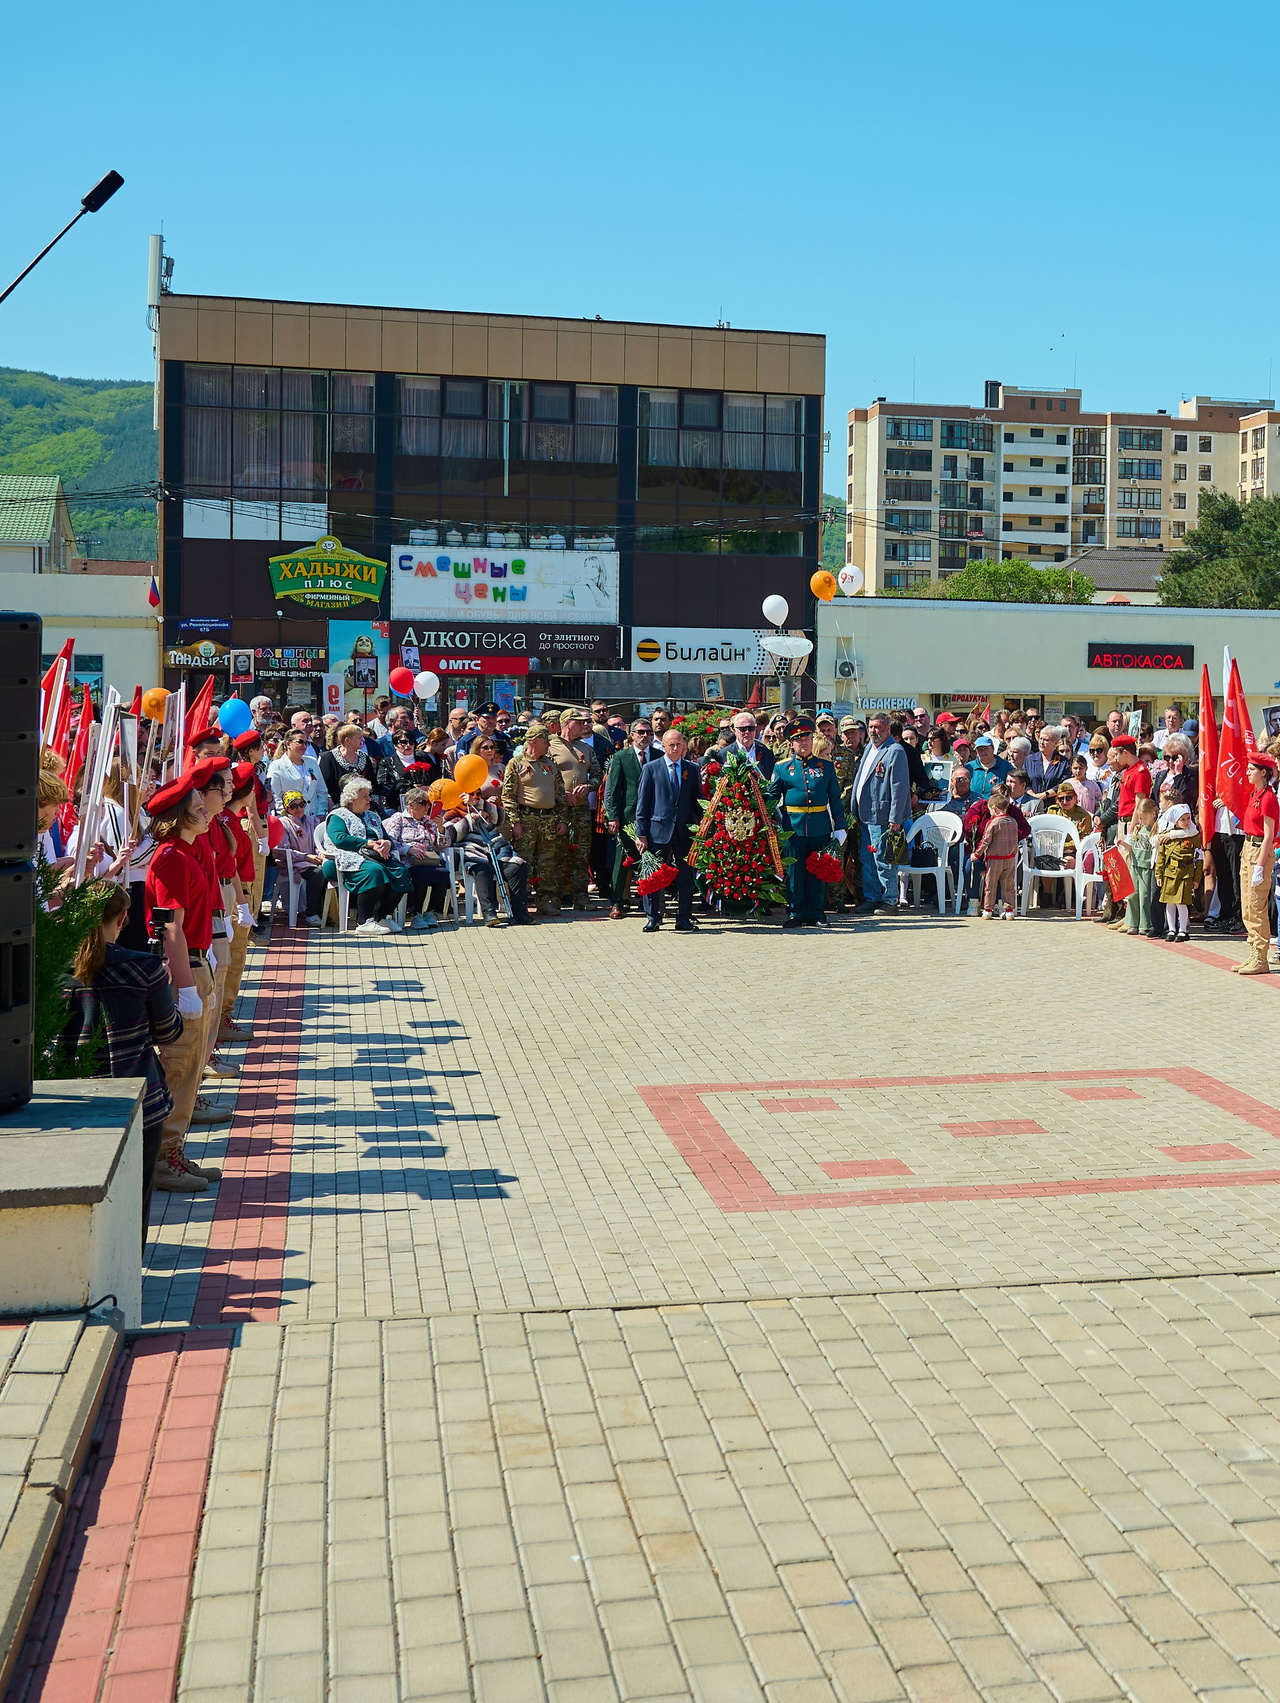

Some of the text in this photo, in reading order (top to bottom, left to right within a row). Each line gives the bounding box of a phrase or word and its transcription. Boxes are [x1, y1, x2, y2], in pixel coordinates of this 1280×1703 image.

[279, 561, 377, 585] ХАДЫЖИ
[304, 580, 353, 590] ПЛЮС
[306, 600, 349, 609] МАГАЗИН
[403, 608, 447, 619] ОДЕЖДА
[457, 610, 465, 619] И
[466, 610, 500, 620] ОБУВЬ
[508, 611, 528, 620] ДЛЯ
[530, 611, 557, 620] ВСЕЙ
[539, 632, 600, 642] От элитного
[538, 642, 595, 651] до простого
[665, 642, 745, 661] Билайн
[169, 650, 231, 667] ТАНДЫР-Т
[254, 648, 326, 659] СМЕШНЫЕ
[269, 658, 312, 669] ЦЕНЫ
[448, 659, 481, 670] МТС
[1092, 655, 1184, 669] АВТОКАССА
[287, 670, 308, 678] ЦЕНЫ
[856, 697, 918, 710] ТАБАКЕРКА
[951, 694, 988, 703] ПРОДУКТЫ
